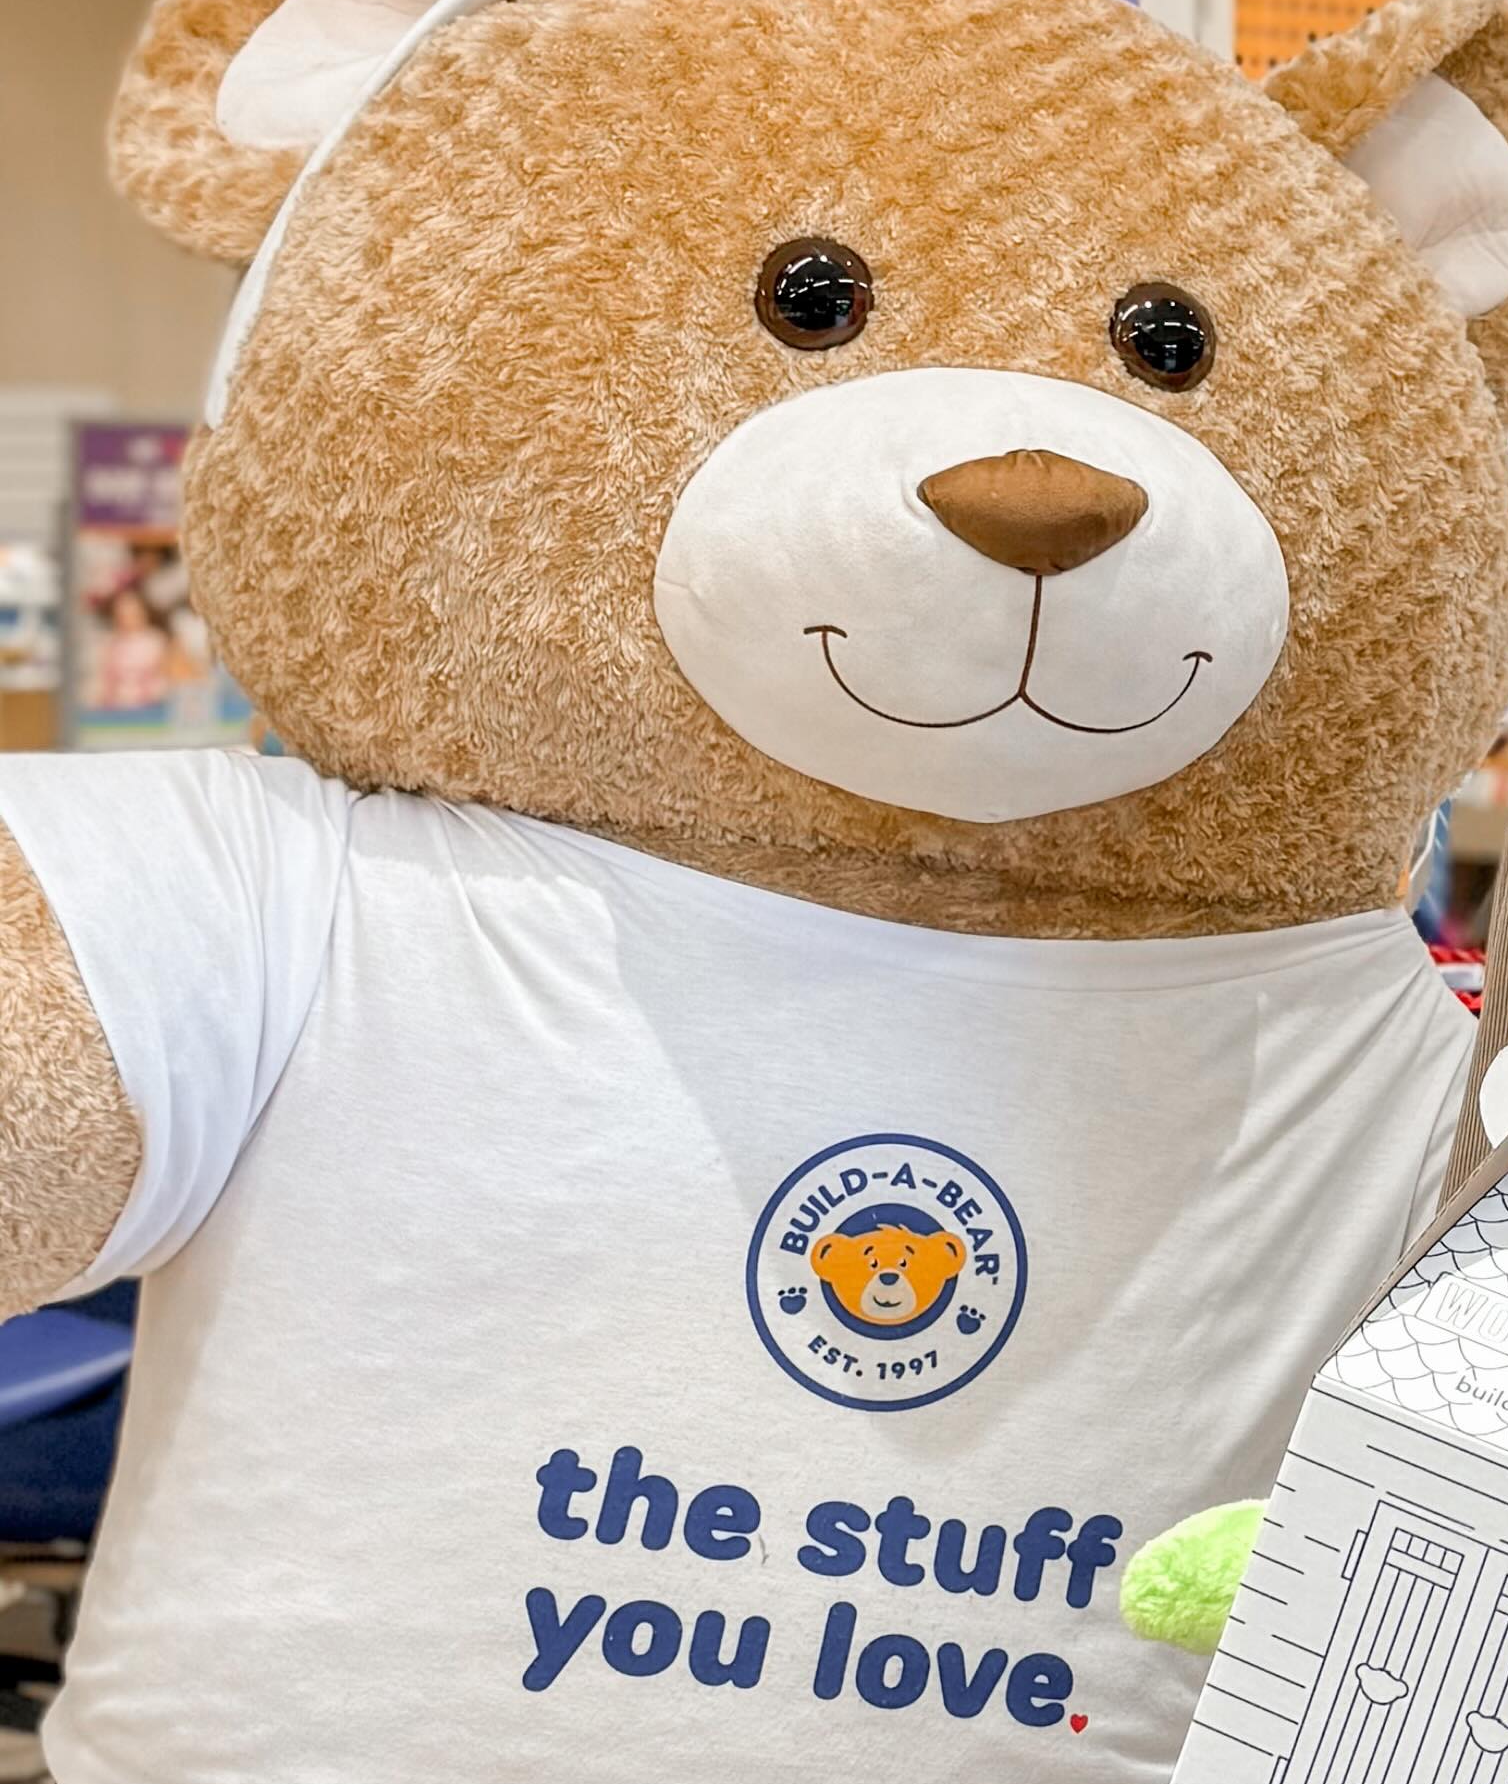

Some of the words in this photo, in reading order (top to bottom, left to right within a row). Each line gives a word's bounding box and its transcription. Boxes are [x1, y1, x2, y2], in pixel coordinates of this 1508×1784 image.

[780, 1162, 1000, 1277] BUILD-A-BEAR
[807, 1334, 864, 1378] EST.
[876, 1350, 939, 1380] 1997
[535, 1445, 762, 1561] the
[797, 1495, 1124, 1610] stuff
[521, 1586, 772, 1693] you
